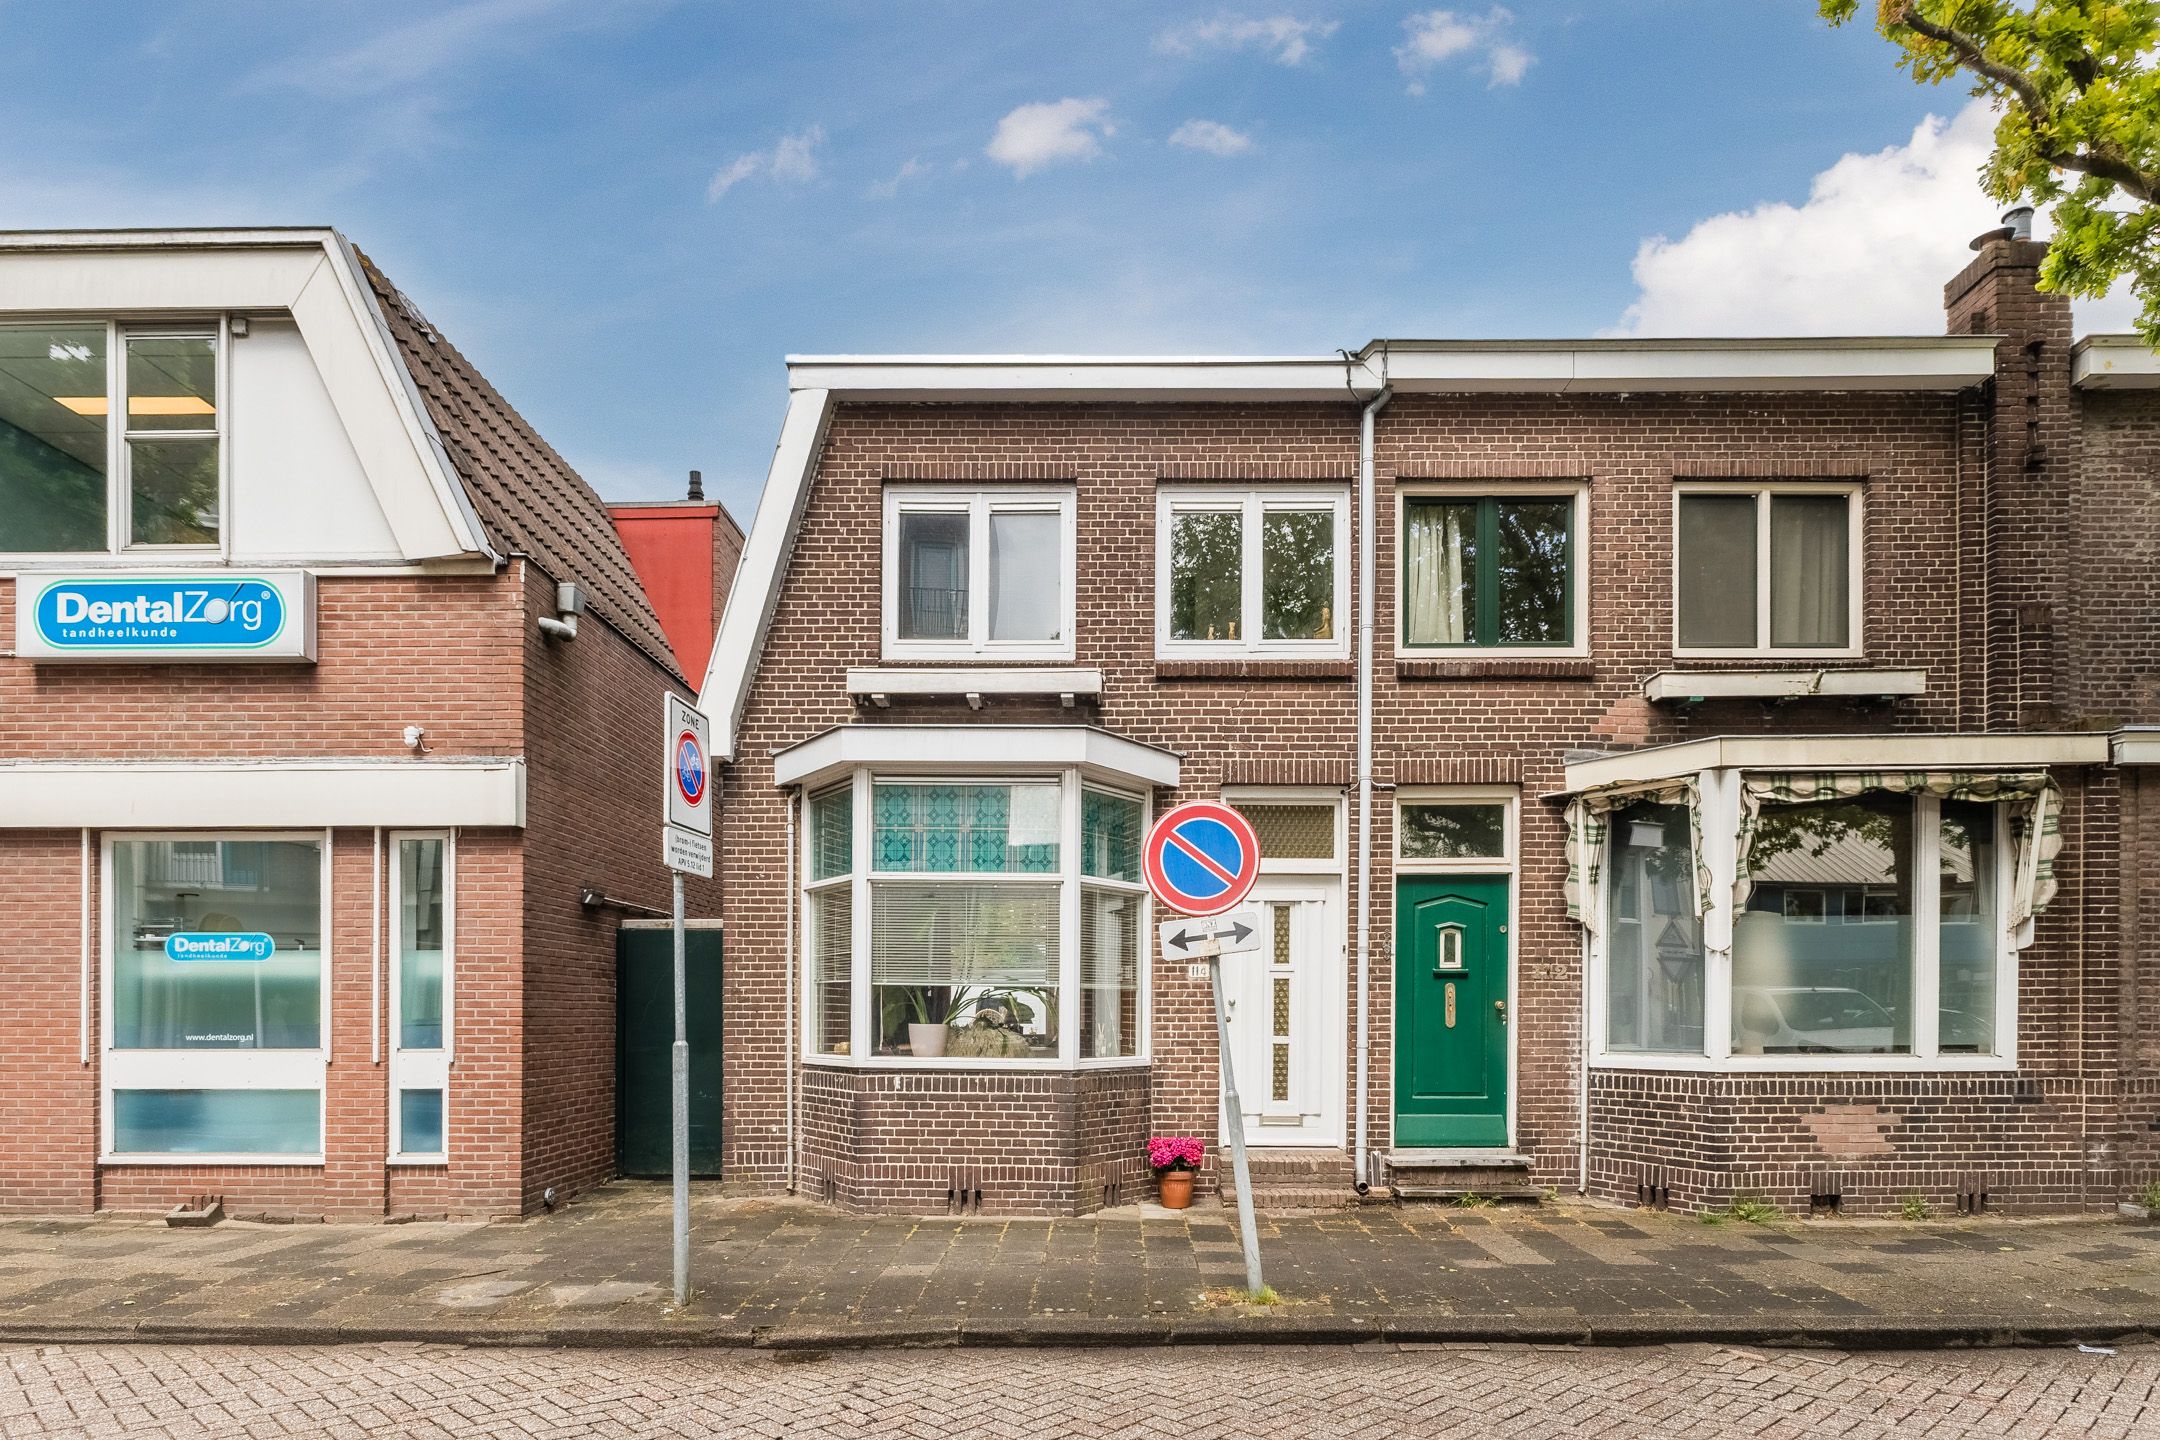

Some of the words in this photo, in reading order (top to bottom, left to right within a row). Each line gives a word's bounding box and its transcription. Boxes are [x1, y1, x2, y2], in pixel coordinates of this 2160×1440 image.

[62, 626, 178, 638] tandheelkunde
[681, 710, 700, 731] ZONE
[671, 845, 688, 857] worden
[1191, 965, 1207, 977] 114
[185, 1033, 254, 1042] www.dentalzorg.nl
